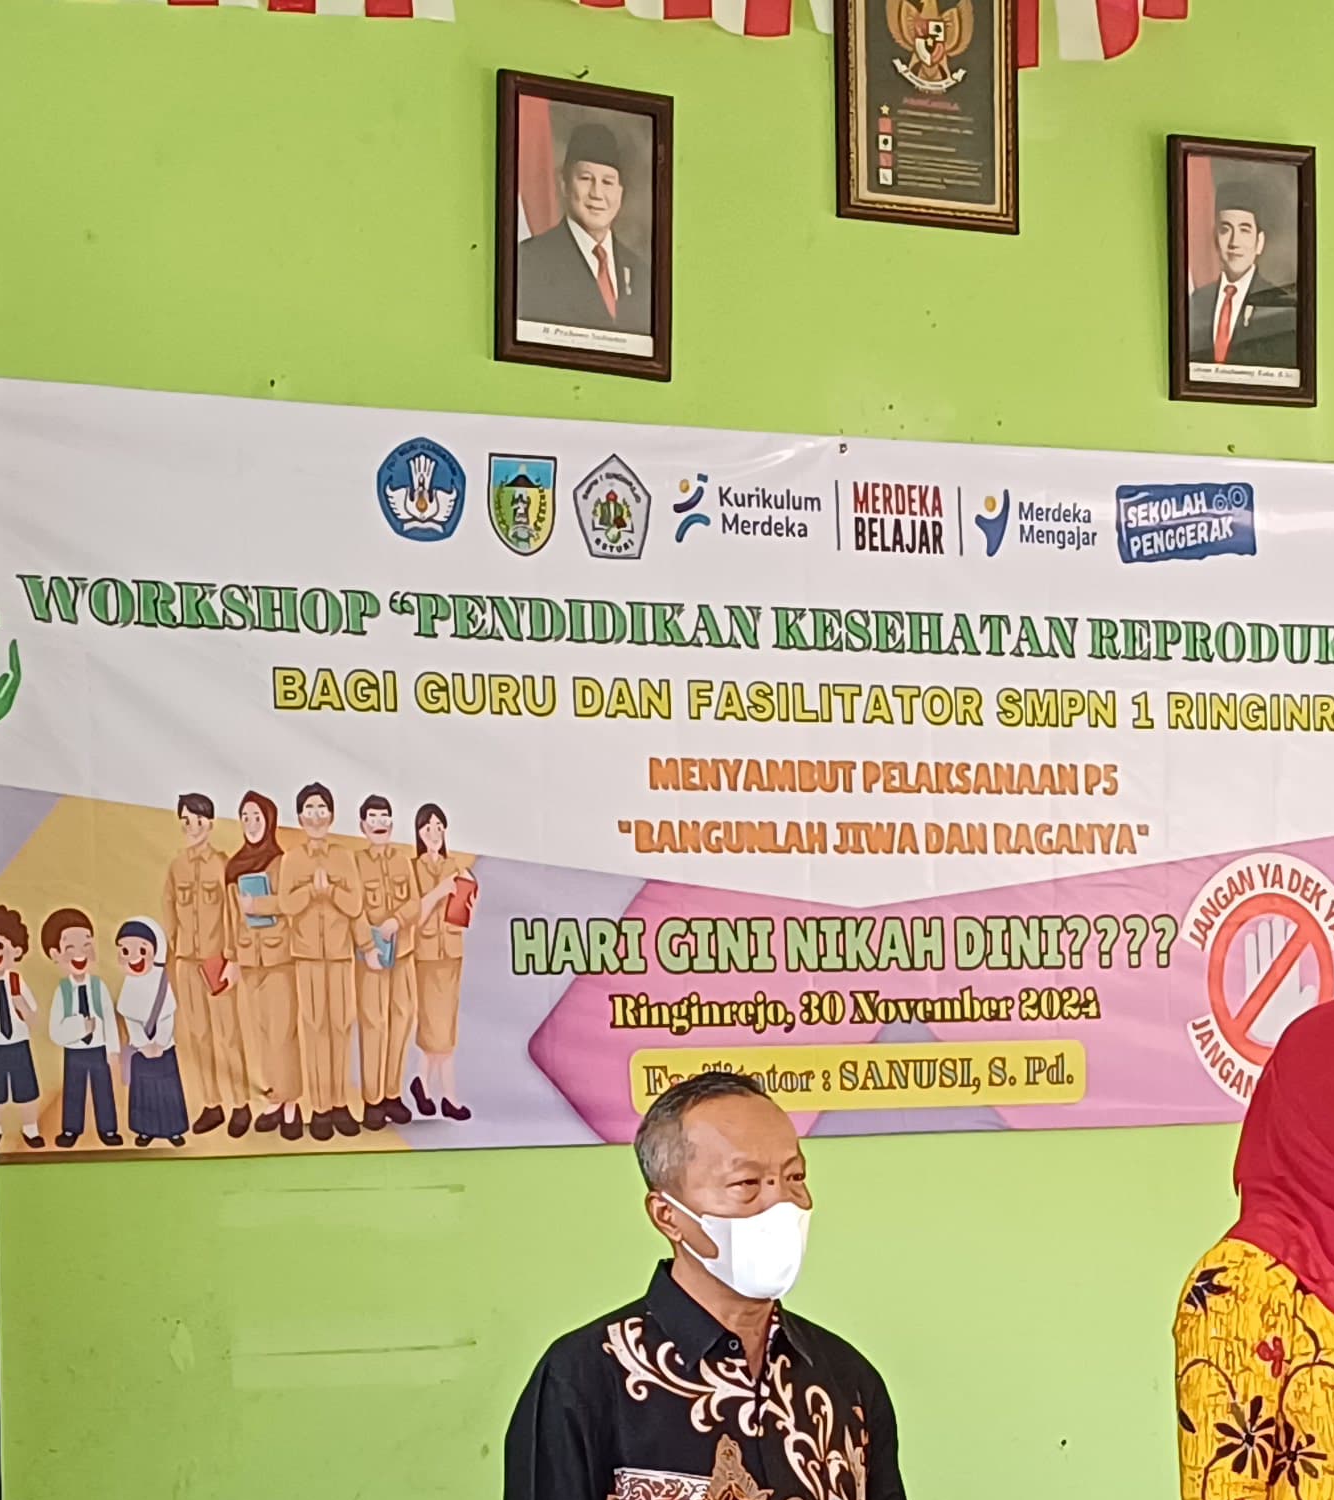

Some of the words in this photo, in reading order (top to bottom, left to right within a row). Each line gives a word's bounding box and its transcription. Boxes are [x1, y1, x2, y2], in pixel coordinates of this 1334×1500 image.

[718, 486, 821, 512] Kurikulum
[853, 481, 943, 517] MERDEKA
[1019, 501, 1091, 523] Merdeka
[1126, 491, 1207, 528] SEKOLAH
[721, 513, 808, 538] Merdeka
[854, 517, 944, 554] BELAJAR
[1019, 525, 1097, 551] Mengajar
[1129, 514, 1233, 558] PENGGERAK
[16, 575, 380, 635] WORKSHOP
[773, 607, 1078, 658] KESEHATAN
[272, 665, 397, 713] BAGI
[415, 671, 556, 716] GURU
[573, 677, 671, 720] DAN
[688, 679, 982, 727] FASILITATOR
[997, 689, 1117, 730] SMPN
[1132, 691, 1155, 730] 1
[649, 757, 856, 793] MENYAMBUT
[863, 761, 1079, 795] PELAKSANAAN
[1084, 764, 1118, 795] P5
[618, 819, 827, 854] "BANGUNLAH
[833, 822, 917, 854] JIWA
[926, 822, 987, 854] DAN
[994, 822, 1149, 855] RAGANYA"
[1189, 866, 1255, 952] JANGAN
[1257, 863, 1283, 889] YA
[1287, 868, 1327, 911] DEK
[511, 918, 645, 974] HARI
[656, 917, 776, 973] GINI
[786, 915, 946, 972] NIKAH
[956, 914, 1178, 971] DINI????
[609, 992, 795, 1035] Ringinrejo,
[800, 991, 845, 1025] 30
[850, 986, 1014, 1024] November
[1019, 988, 1101, 1020] 2024
[839, 1058, 981, 1093] SANUSI,
[988, 1057, 1016, 1087] S.
[1025, 1053, 1074, 1085] Pd.
